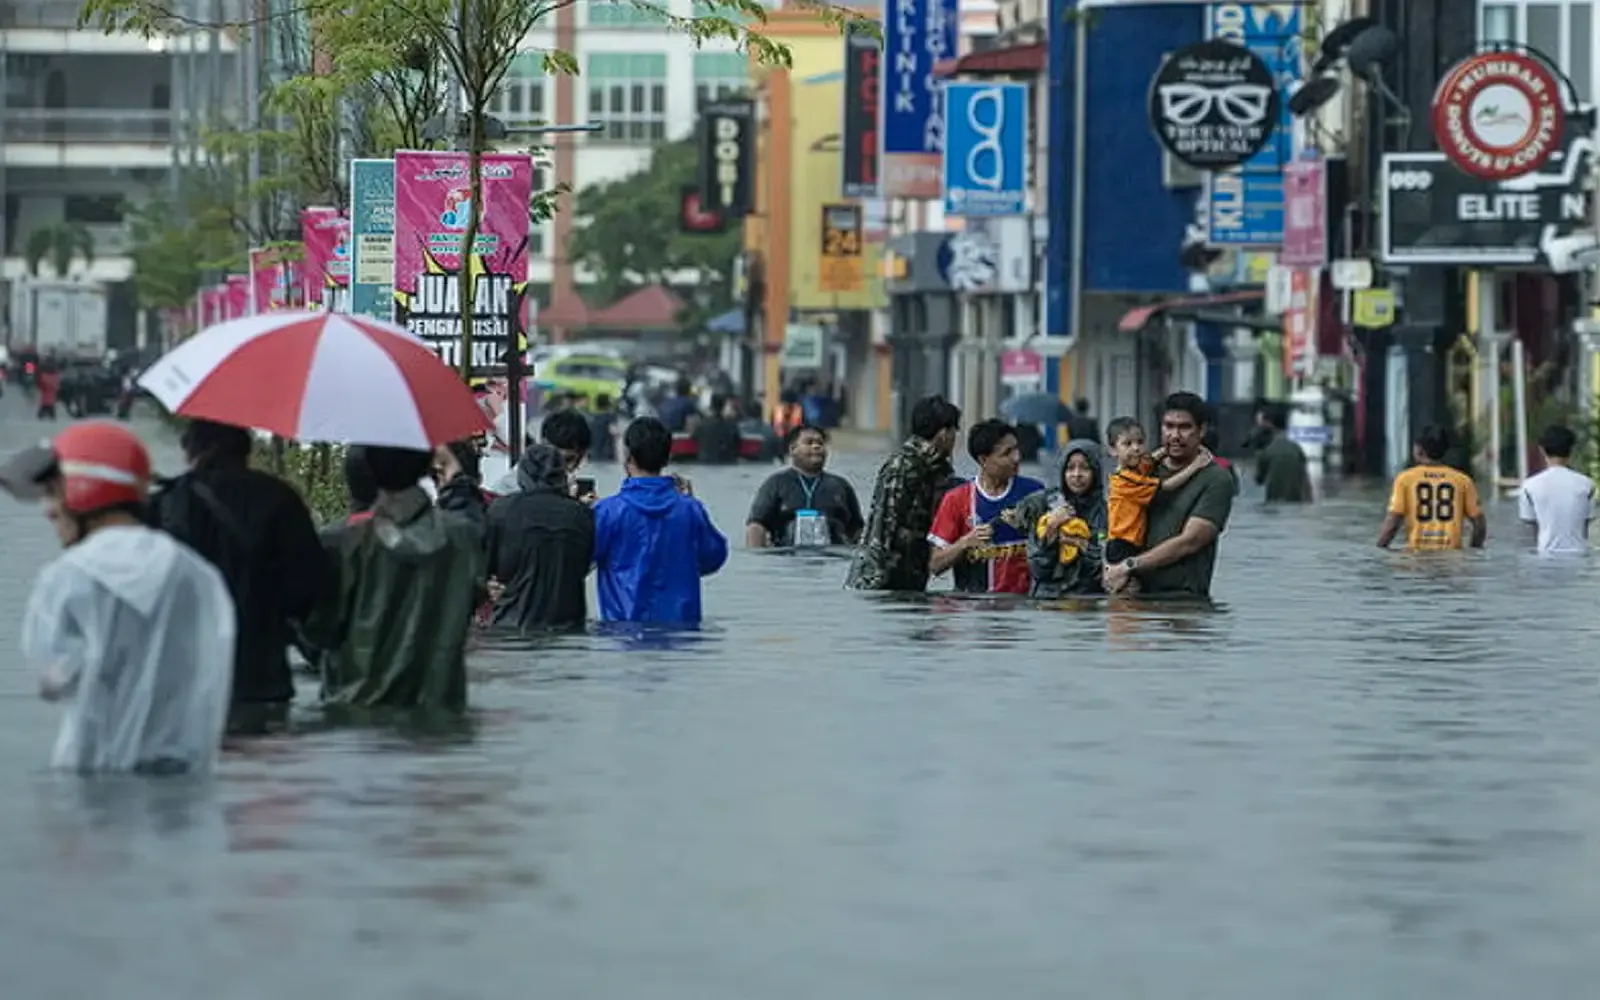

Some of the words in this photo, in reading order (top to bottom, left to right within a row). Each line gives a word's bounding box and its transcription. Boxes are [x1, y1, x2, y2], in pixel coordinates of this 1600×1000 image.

[1458, 193, 1541, 220] ELITE
[408, 273, 513, 314] JUAAN
[1415, 482, 1455, 522] 88
